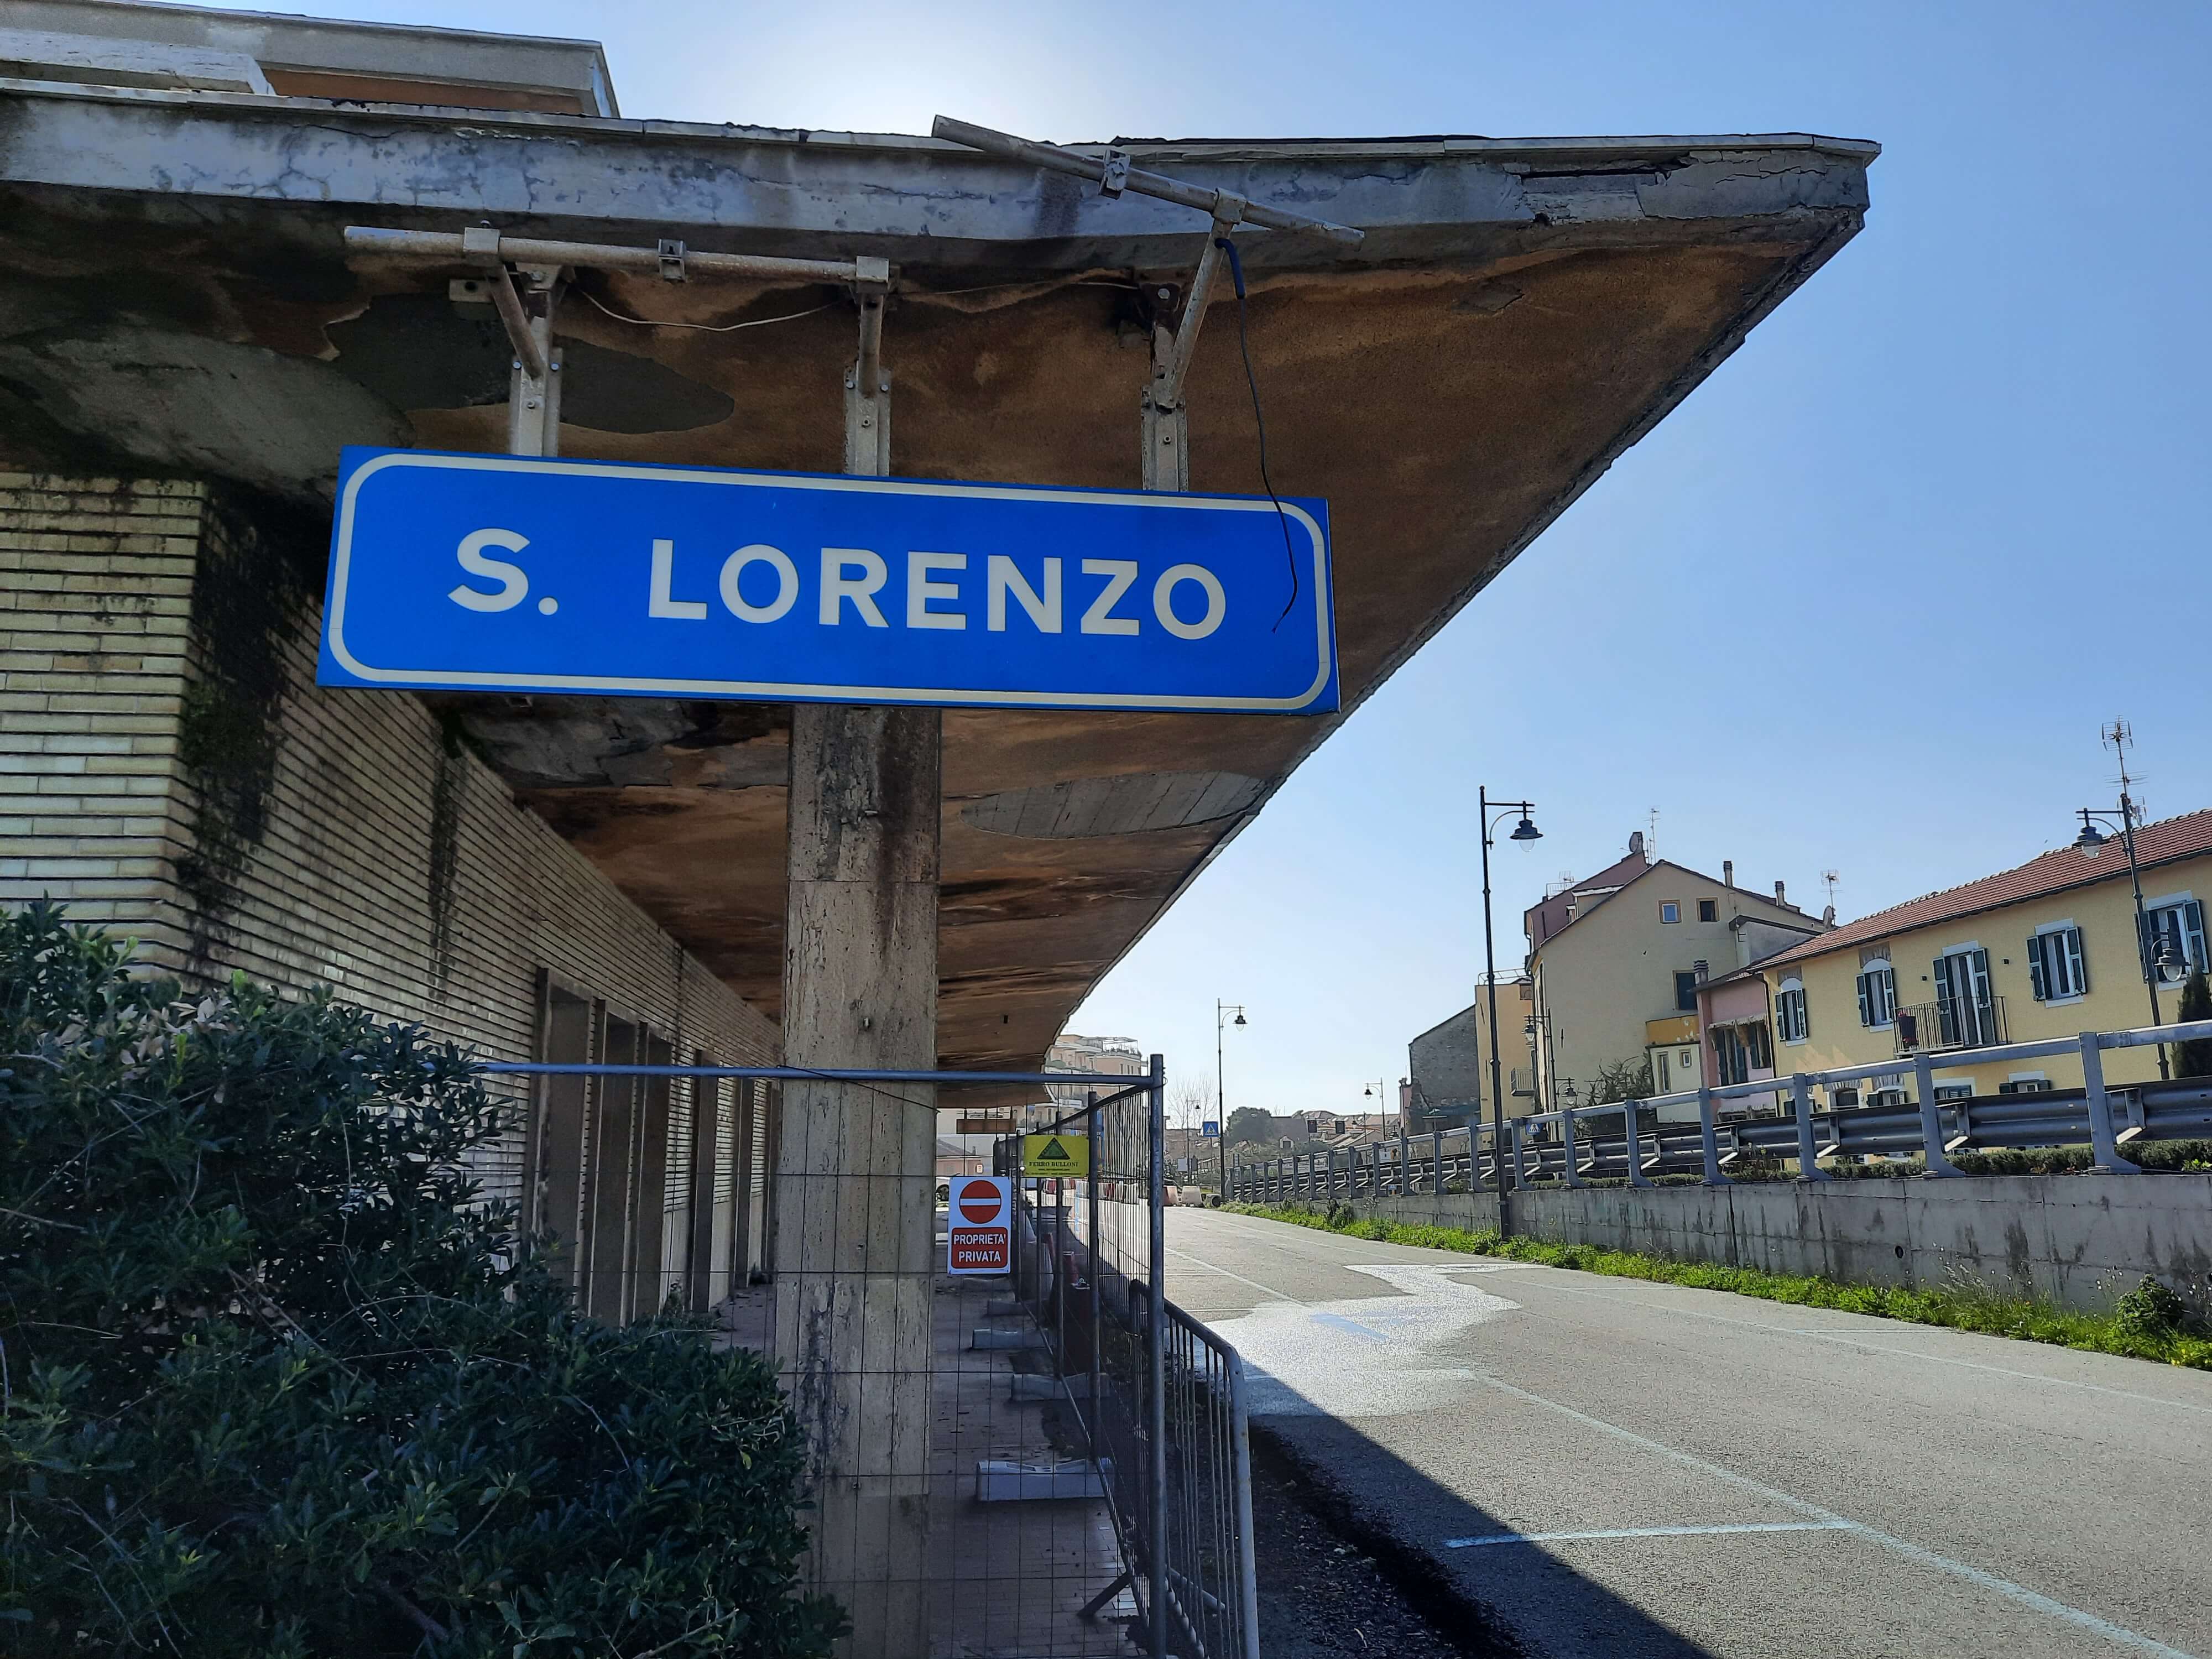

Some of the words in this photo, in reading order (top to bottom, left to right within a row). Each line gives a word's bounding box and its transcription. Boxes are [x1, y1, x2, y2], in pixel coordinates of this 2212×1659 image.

[447, 528, 559, 616] S.
[648, 539, 1227, 640] LORENZO
[953, 1234, 1005, 1245] PROPRIETA'
[958, 1251, 1001, 1262] PRIVATA
